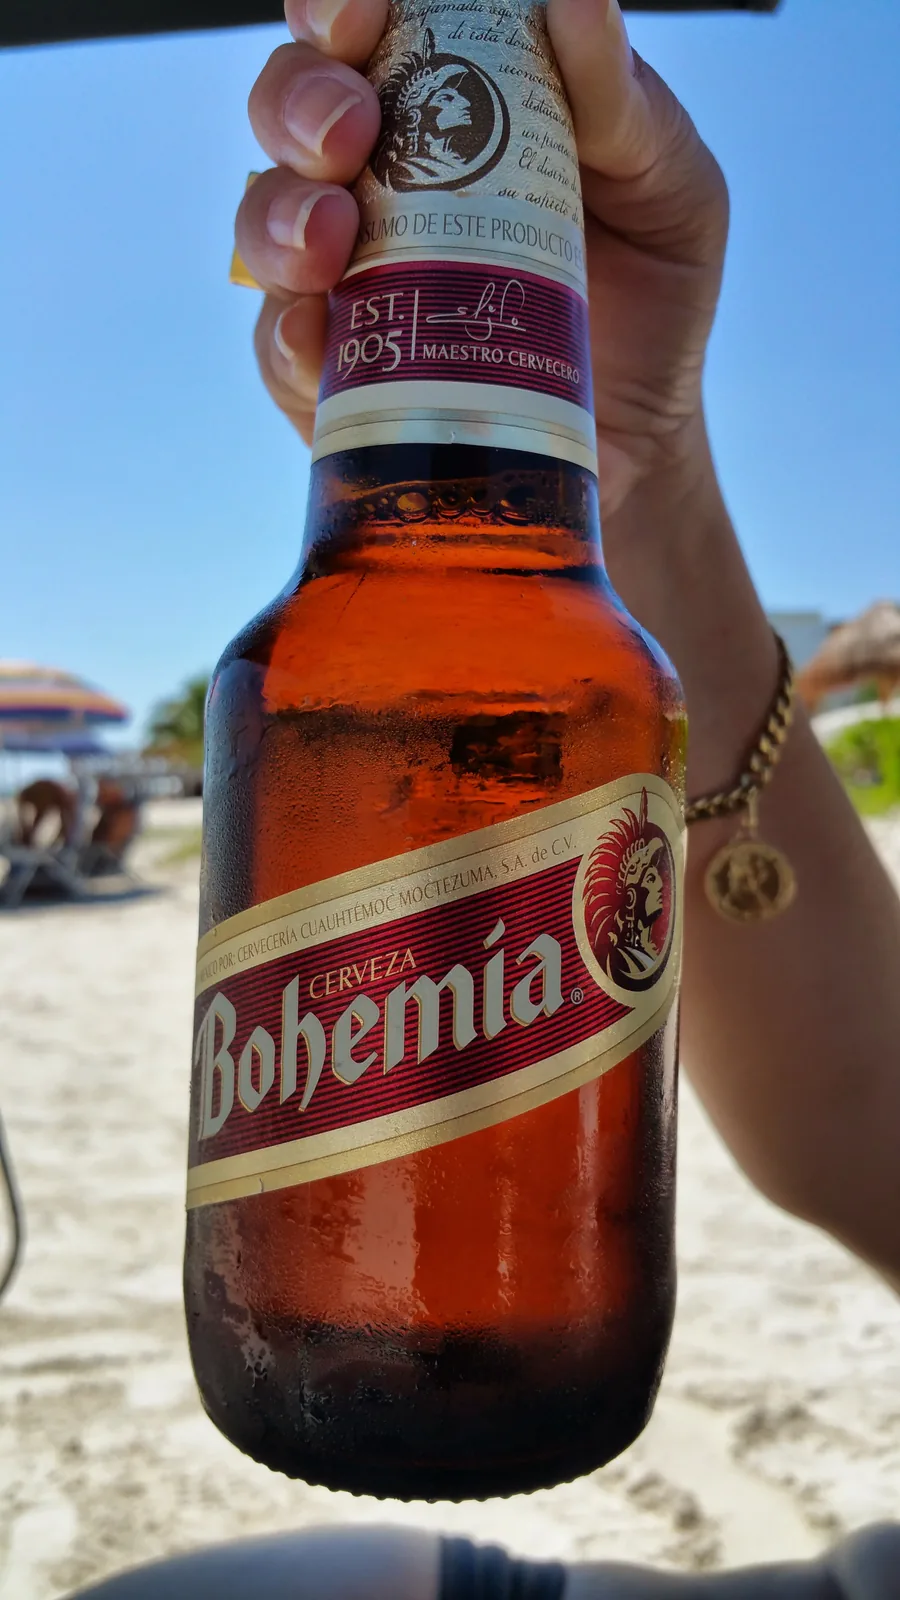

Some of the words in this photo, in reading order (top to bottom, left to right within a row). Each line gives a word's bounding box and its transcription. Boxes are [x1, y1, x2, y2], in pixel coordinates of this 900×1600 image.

[448, 20, 464, 40] de
[469, 26, 505, 43] esta
[521, 129, 541, 142] un
[518, 147, 538, 170] El
[497, 187, 519, 200] su
[525, 191, 572, 216] aspecto
[360, 214, 408, 246] SUMO
[412, 212, 439, 235] DE
[443, 213, 487, 238] ESTE
[491, 217, 573, 262] PRODUCTO
[349, 291, 405, 331] EST.
[336, 330, 403, 381] 1905
[422, 343, 503, 364] MAESTRO
[507, 350, 580, 385] CERVECERO
[237, 924, 299, 963] CERVECERÍA
[300, 893, 398, 940] CUAUHTÉMOC
[399, 865, 498, 908] MOCTEZUMA,
[501, 853, 528, 875] S.A.
[531, 846, 549, 864] de
[551, 833, 578, 857] C.V.
[308, 946, 418, 1000] CERVEZA
[193, 917, 566, 1142] Bohemía
